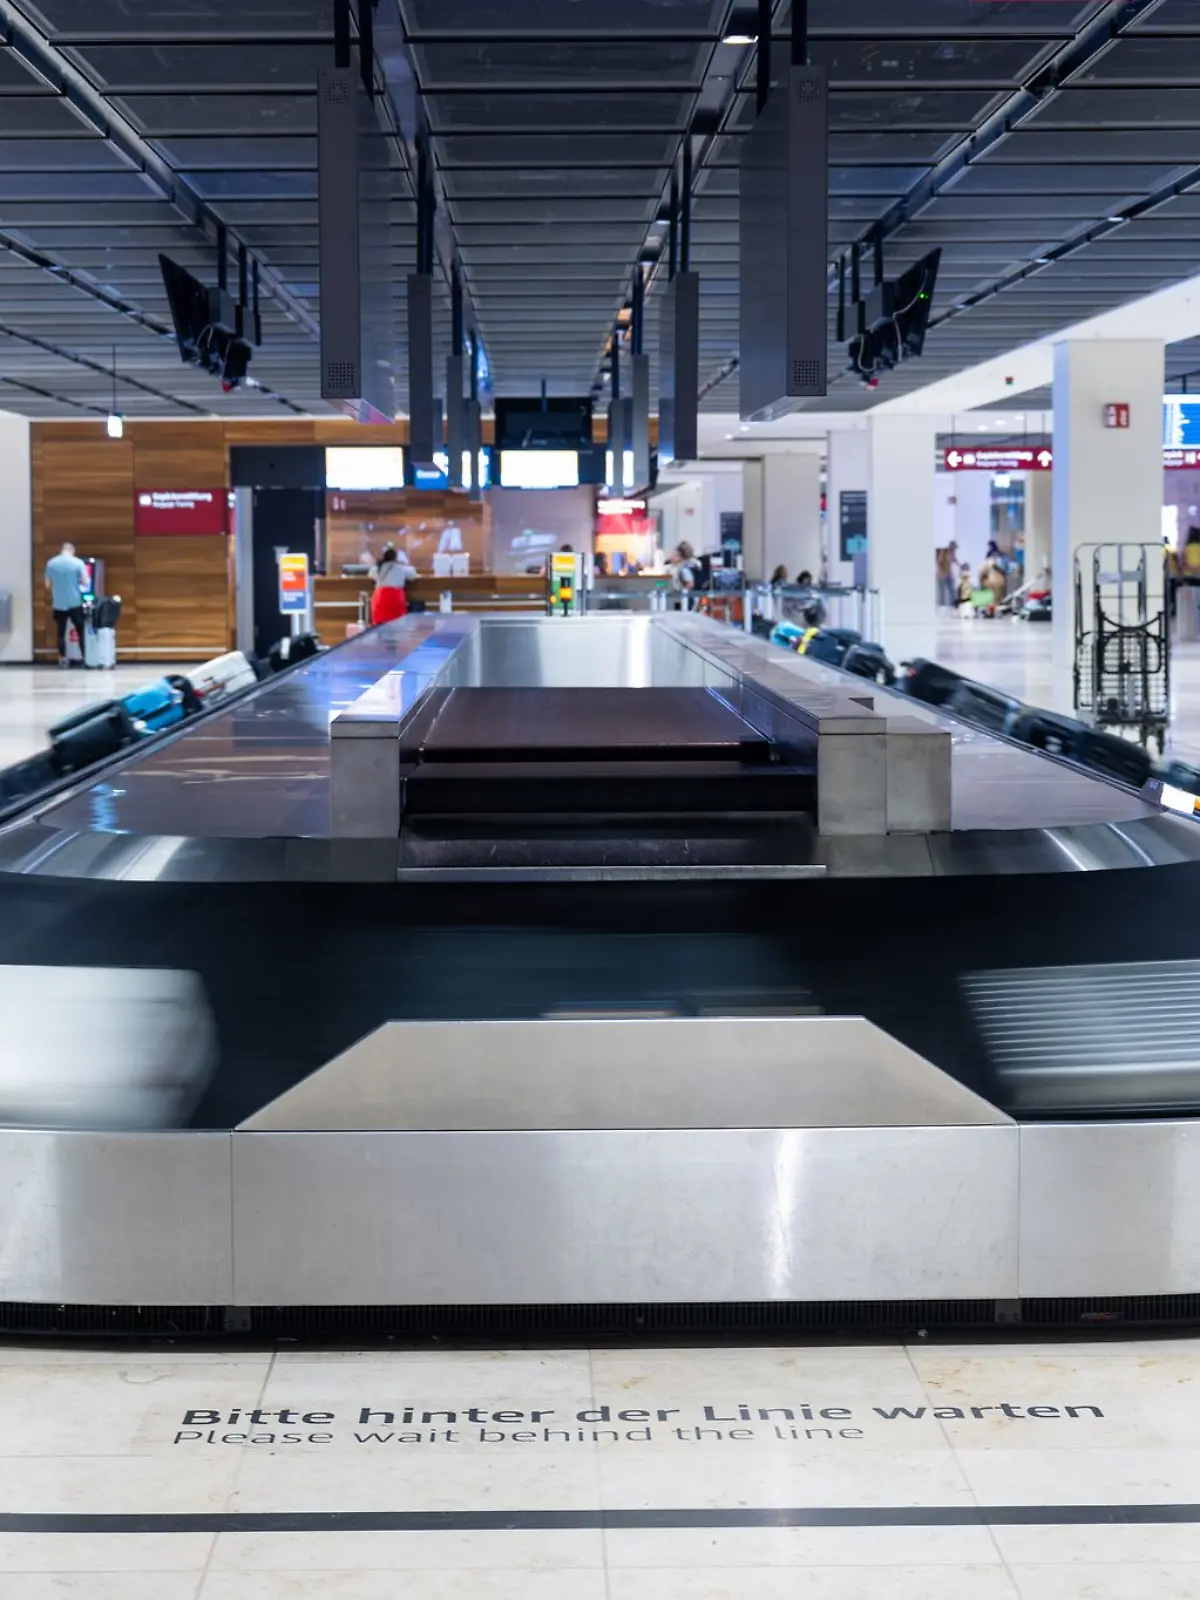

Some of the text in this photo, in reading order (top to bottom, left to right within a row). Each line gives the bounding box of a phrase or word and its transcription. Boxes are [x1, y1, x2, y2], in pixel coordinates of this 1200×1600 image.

[181, 1402, 1105, 1426] Bitte hinter der Linie warten
[173, 1426, 865, 1445] Please wait behind the line
